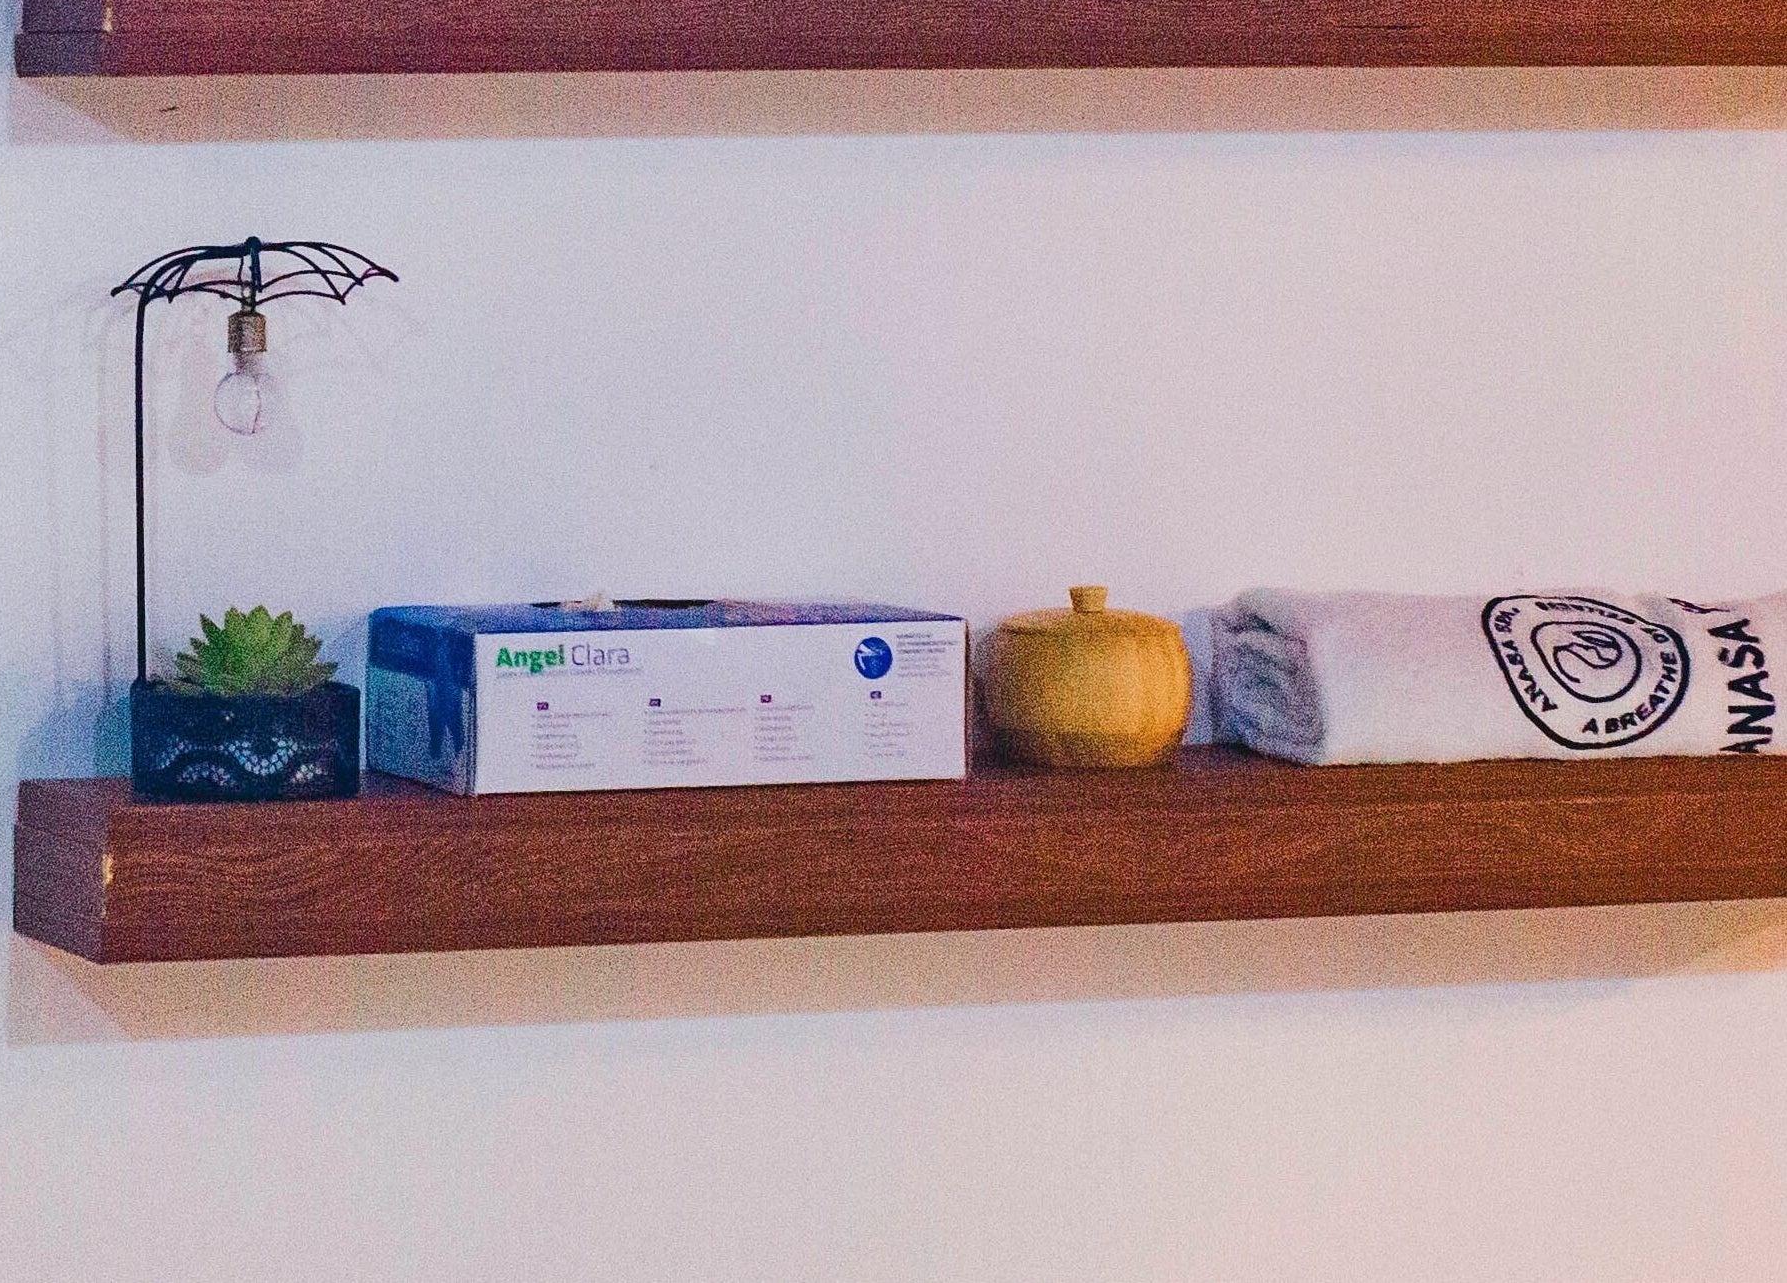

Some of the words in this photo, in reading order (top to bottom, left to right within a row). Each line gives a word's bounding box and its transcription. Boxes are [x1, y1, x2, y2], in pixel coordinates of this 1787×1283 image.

[497, 644, 564, 674] Angel
[571, 642, 630, 666] Clara
[1605, 652, 1678, 734] BREATHE
[1706, 618, 1776, 754] ANASA
